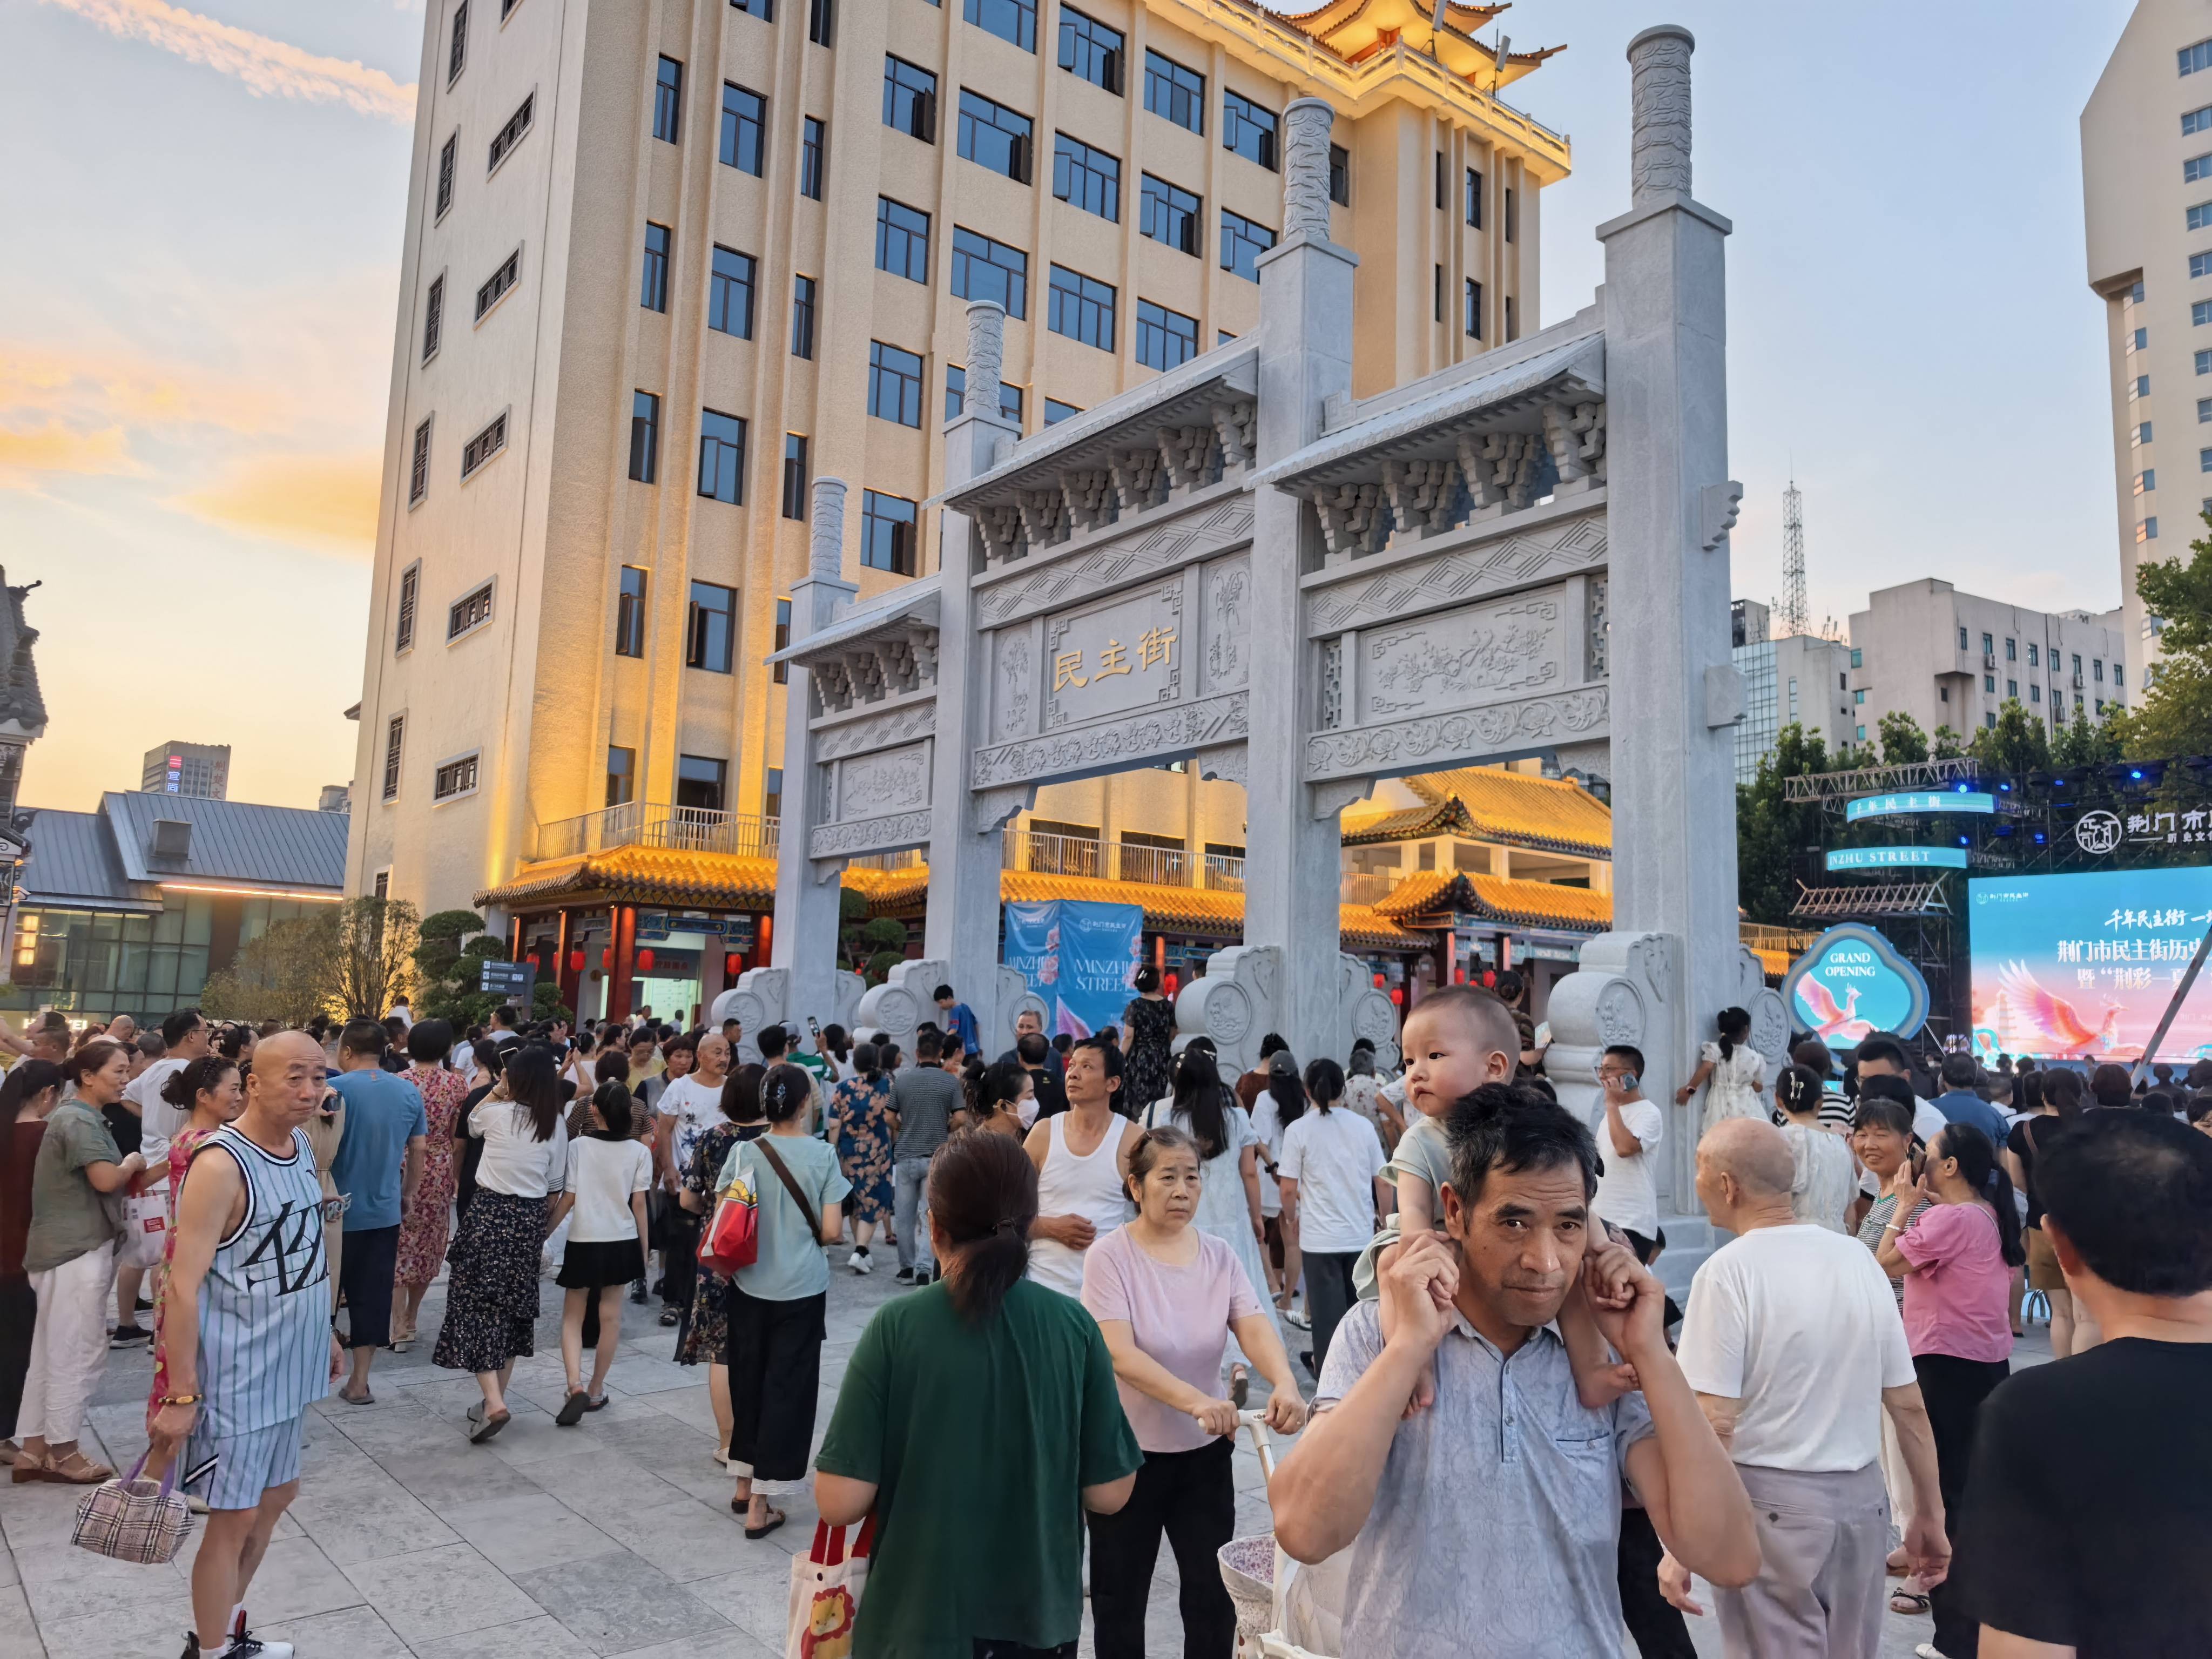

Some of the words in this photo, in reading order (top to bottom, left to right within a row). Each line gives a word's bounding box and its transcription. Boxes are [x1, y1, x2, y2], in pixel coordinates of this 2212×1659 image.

[1054, 626, 1178, 692] 民主街
[2127, 810, 2212, 833] 荆门市
[1870, 851, 1930, 862] STREET
[2105, 908, 2189, 933] 千年民主街
[1830, 953, 1871, 963] GRAND
[1825, 966, 1876, 977] OPENING
